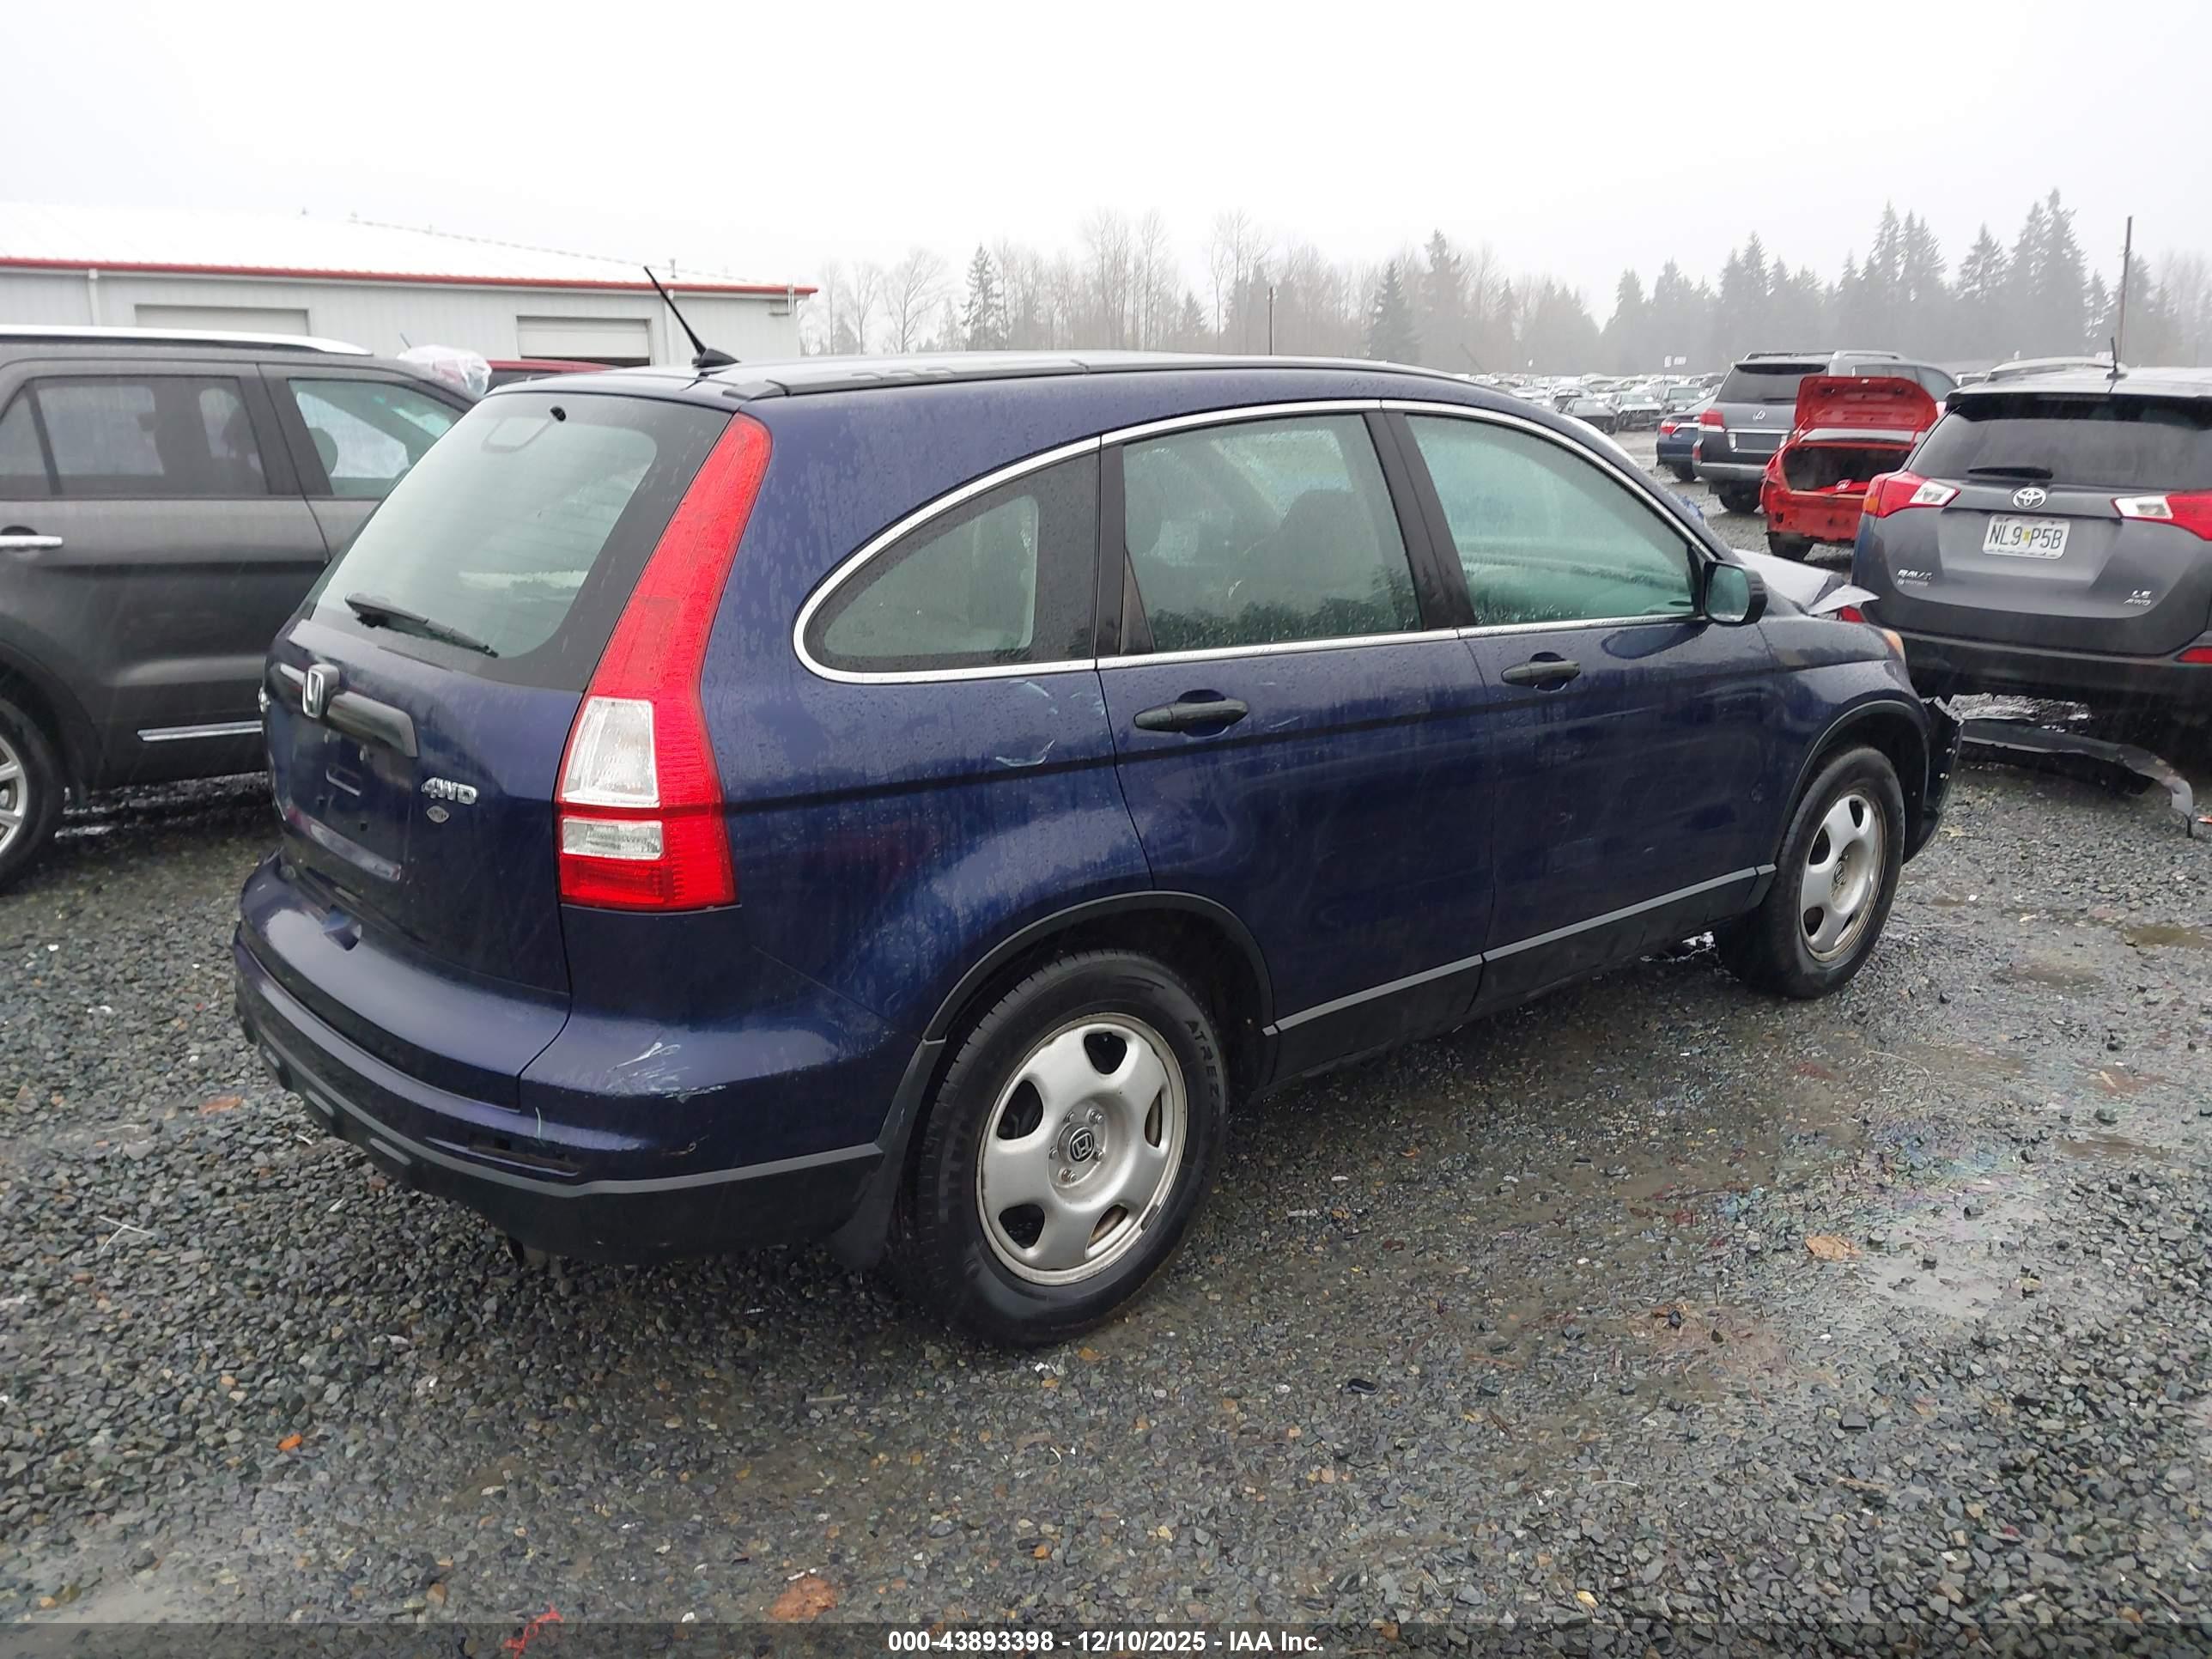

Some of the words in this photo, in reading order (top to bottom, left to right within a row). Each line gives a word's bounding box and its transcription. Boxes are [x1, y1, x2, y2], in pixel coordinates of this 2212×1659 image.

[1989, 524, 2023, 546] NL9
[2027, 527, 2063, 550] P5B
[421, 776, 478, 805] 4WD
[1184, 1020, 1221, 1132] ATREZZ
